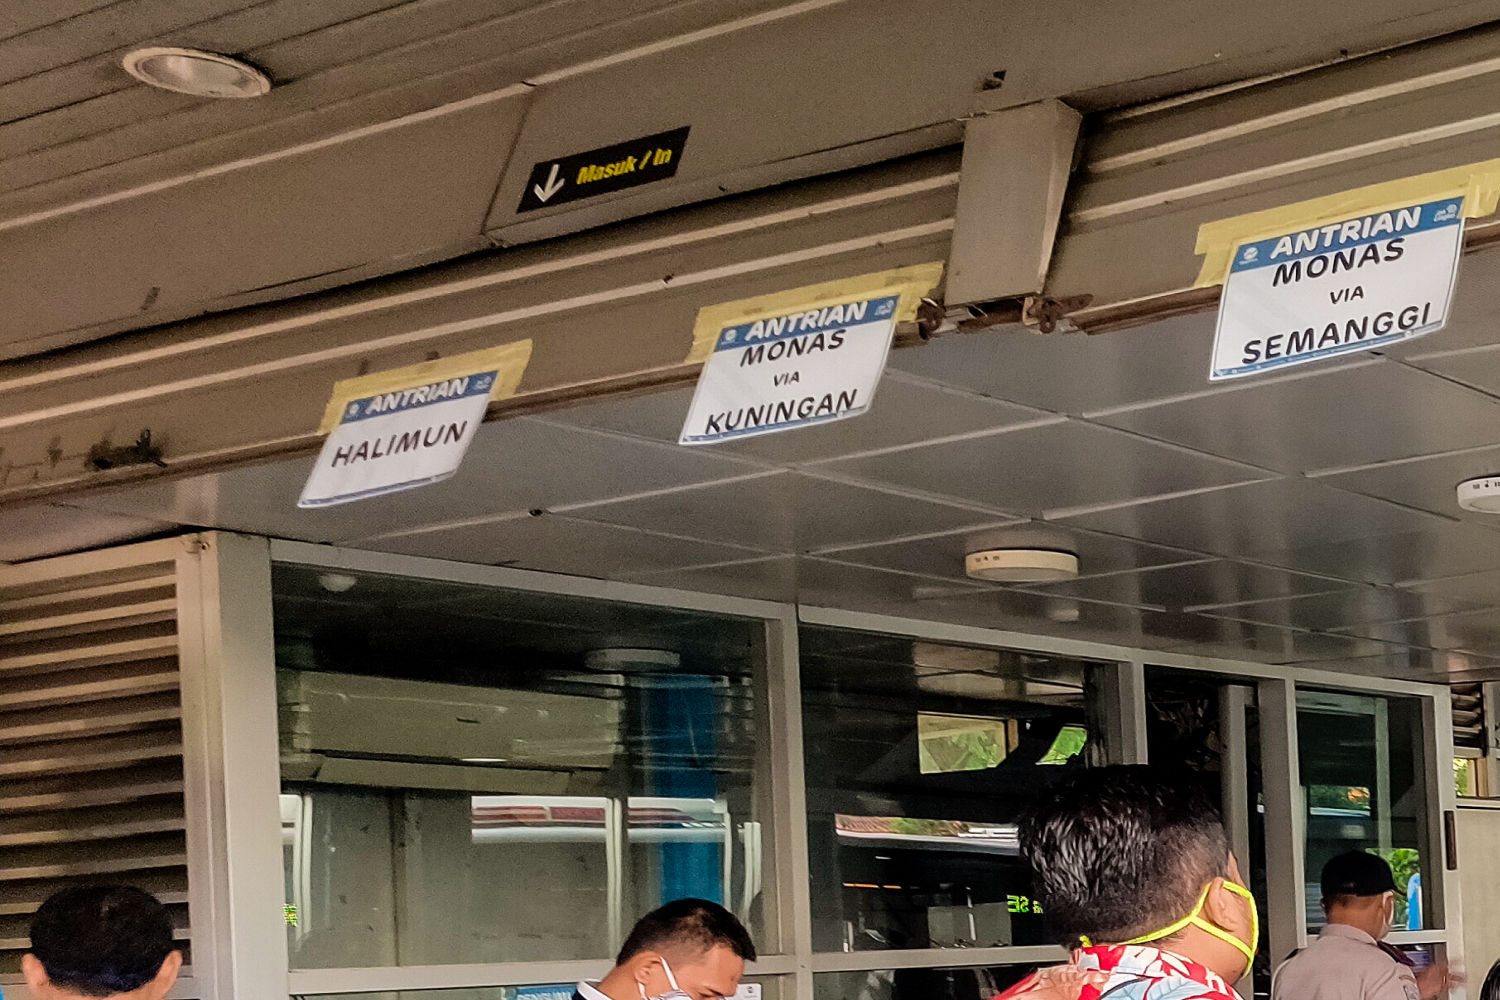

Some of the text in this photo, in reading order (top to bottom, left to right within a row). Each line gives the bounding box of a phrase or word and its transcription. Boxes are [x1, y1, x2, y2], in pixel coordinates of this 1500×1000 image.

[576, 155, 638, 185] Masuk
[652, 148, 672, 166] In
[1270, 206, 1421, 259] ANTRIAN
[1272, 238, 1406, 287] MONAS
[1329, 285, 1365, 304] VIA
[744, 301, 868, 342] ANTRIAN
[1241, 302, 1431, 365] SEMANGGI
[740, 329, 846, 367] MONAS
[365, 377, 470, 415] ANTRIAN
[773, 371, 801, 387] VIA
[705, 388, 858, 435] KUNINGAN
[331, 420, 468, 468] HALIMUN
